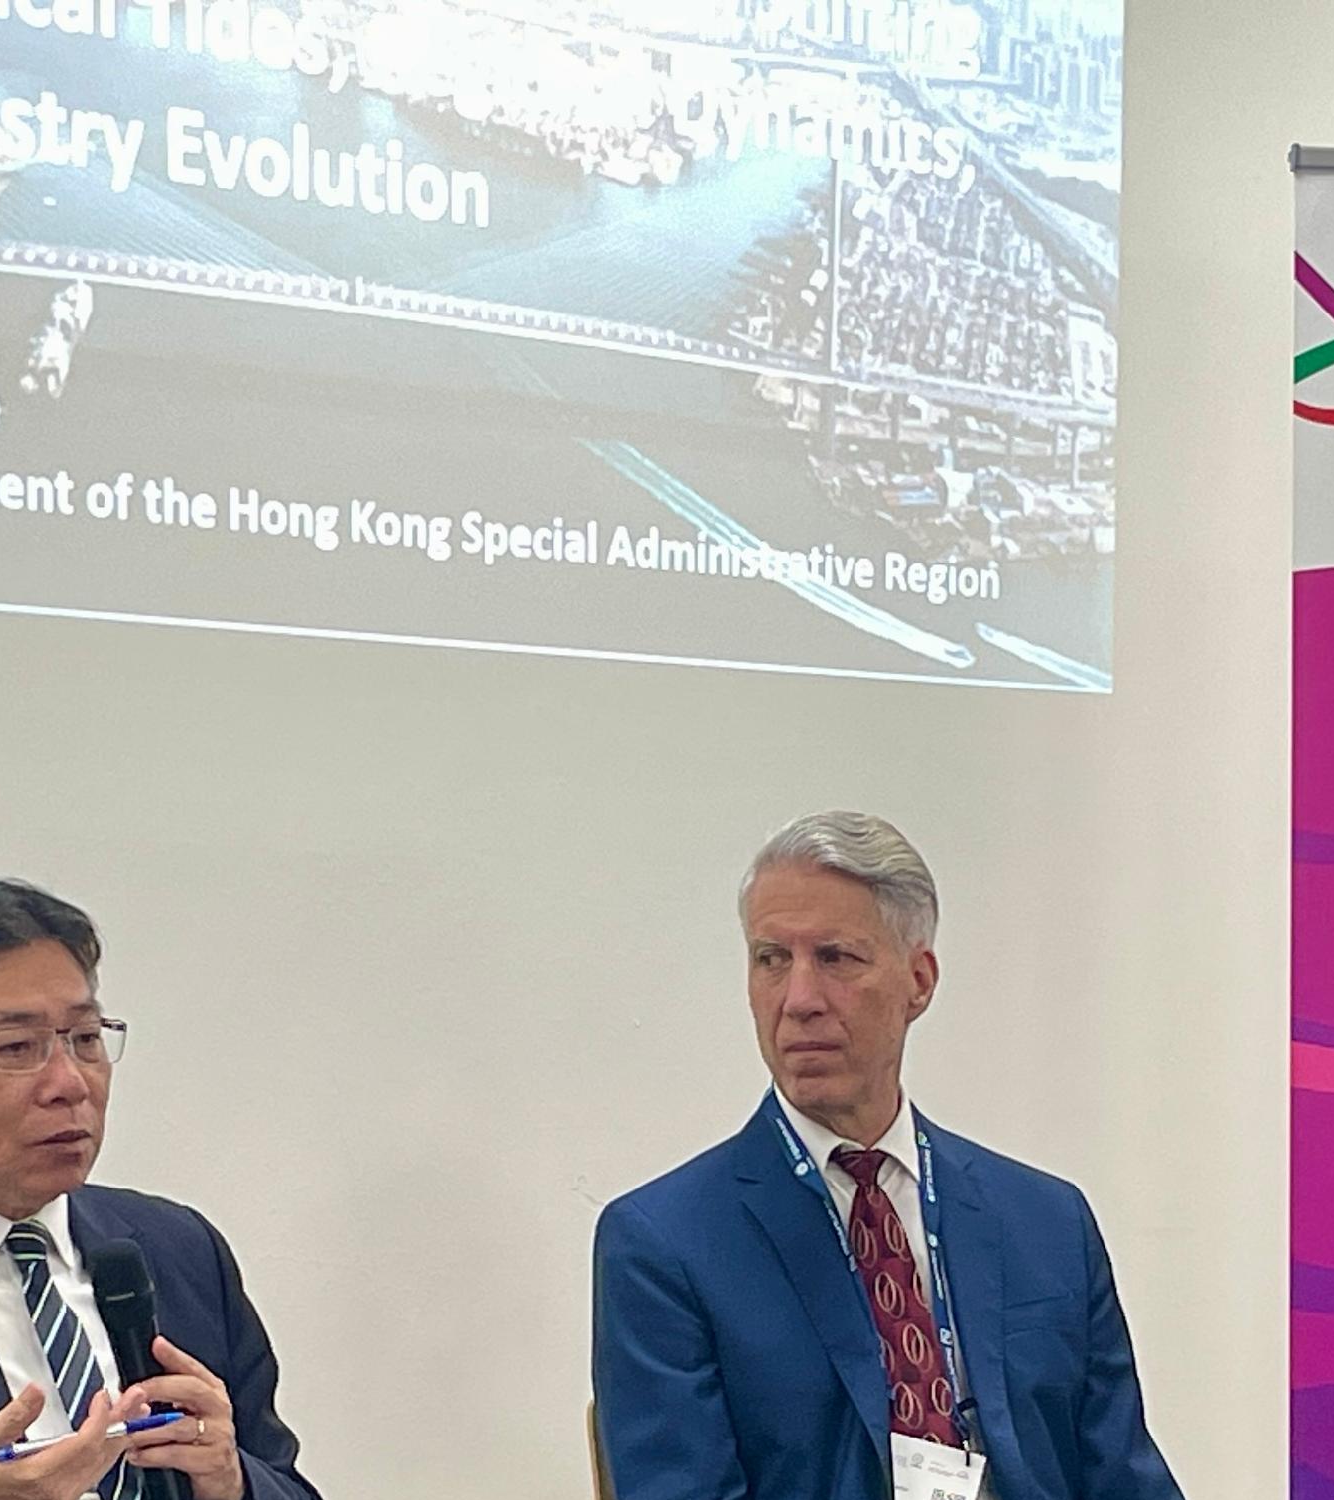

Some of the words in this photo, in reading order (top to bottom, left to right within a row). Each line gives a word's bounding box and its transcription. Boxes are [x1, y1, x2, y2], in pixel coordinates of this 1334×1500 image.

[167, 106, 489, 228] Evolution
[86, 472, 134, 520] of
[143, 476, 218, 529] the
[229, 487, 339, 551] Hong
[351, 499, 452, 562] Kong
[461, 511, 598, 564] Special
[607, 525, 874, 589] Administrative
[885, 552, 1000, 604] Region
